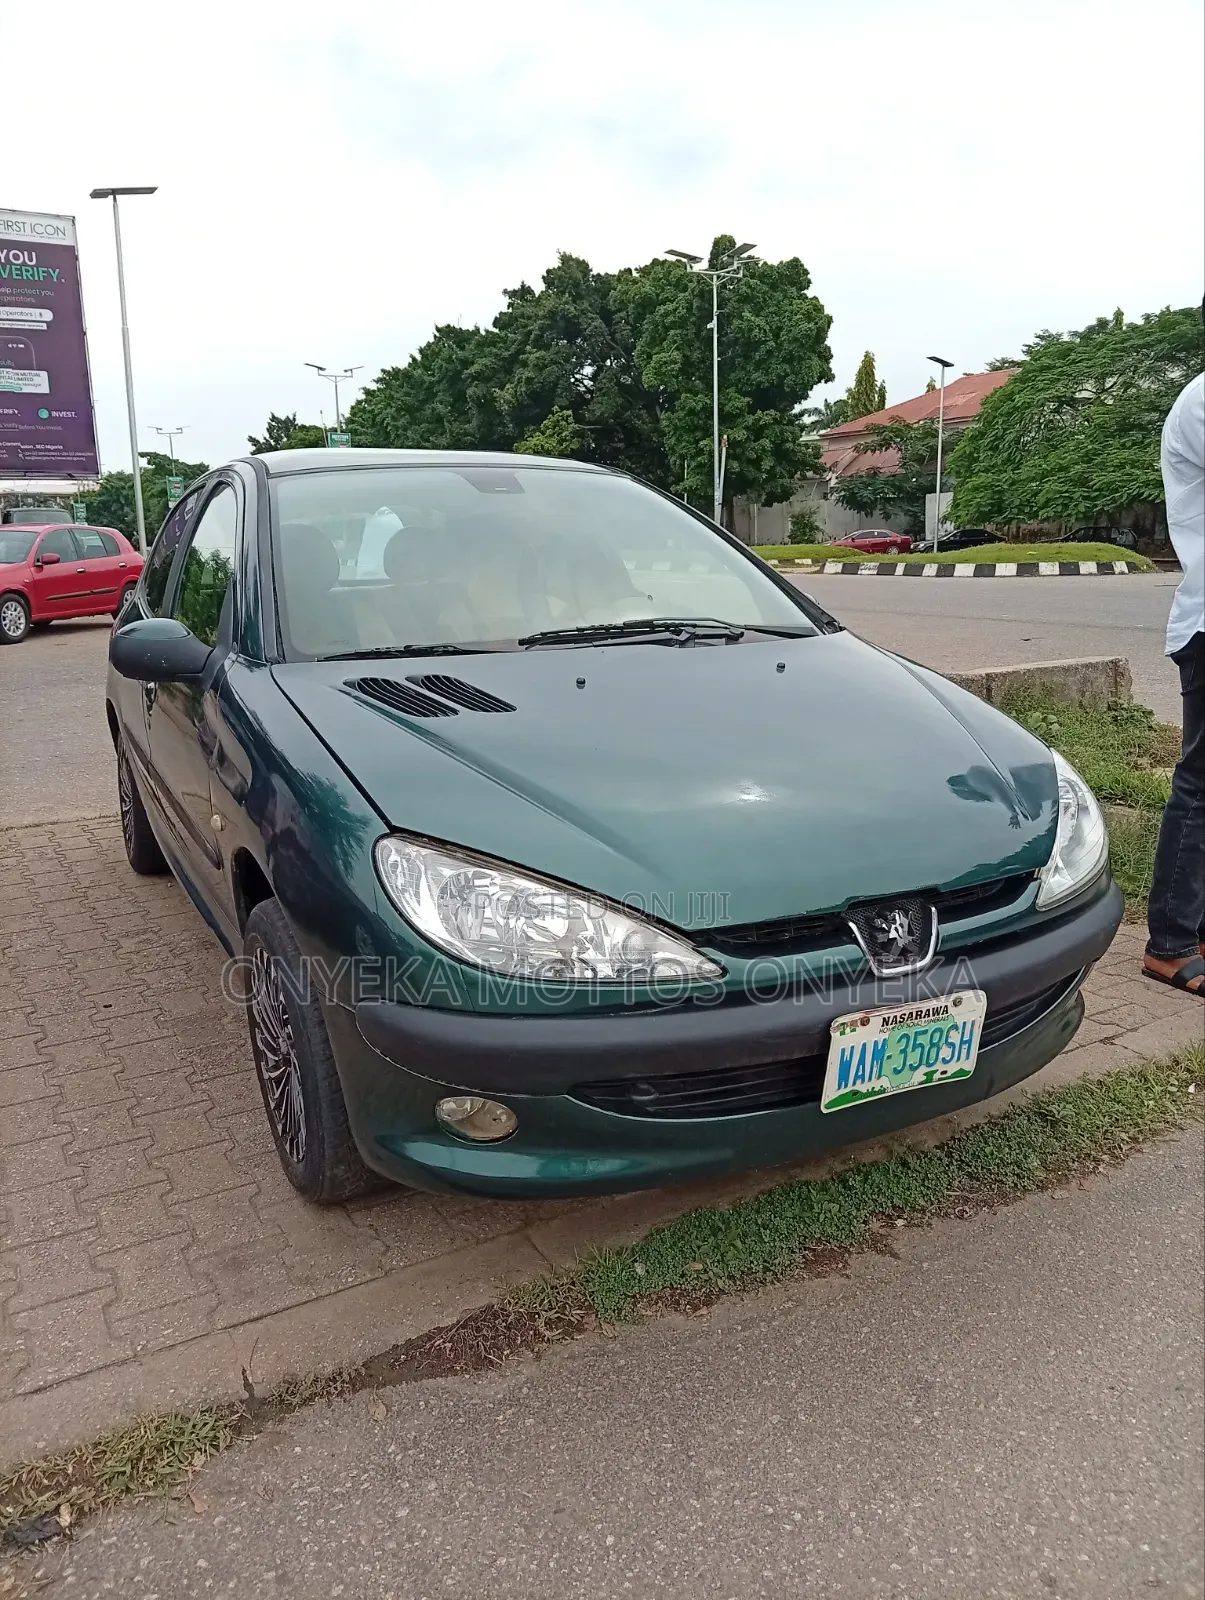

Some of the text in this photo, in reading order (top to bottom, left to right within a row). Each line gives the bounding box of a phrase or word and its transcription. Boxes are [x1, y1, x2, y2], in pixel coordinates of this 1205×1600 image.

[30, 223, 66, 237] ICON
[0, 249, 37, 265] YOU
[881, 1005, 949, 1027] NASARAWA
[878, 1024, 897, 1035] HOME
